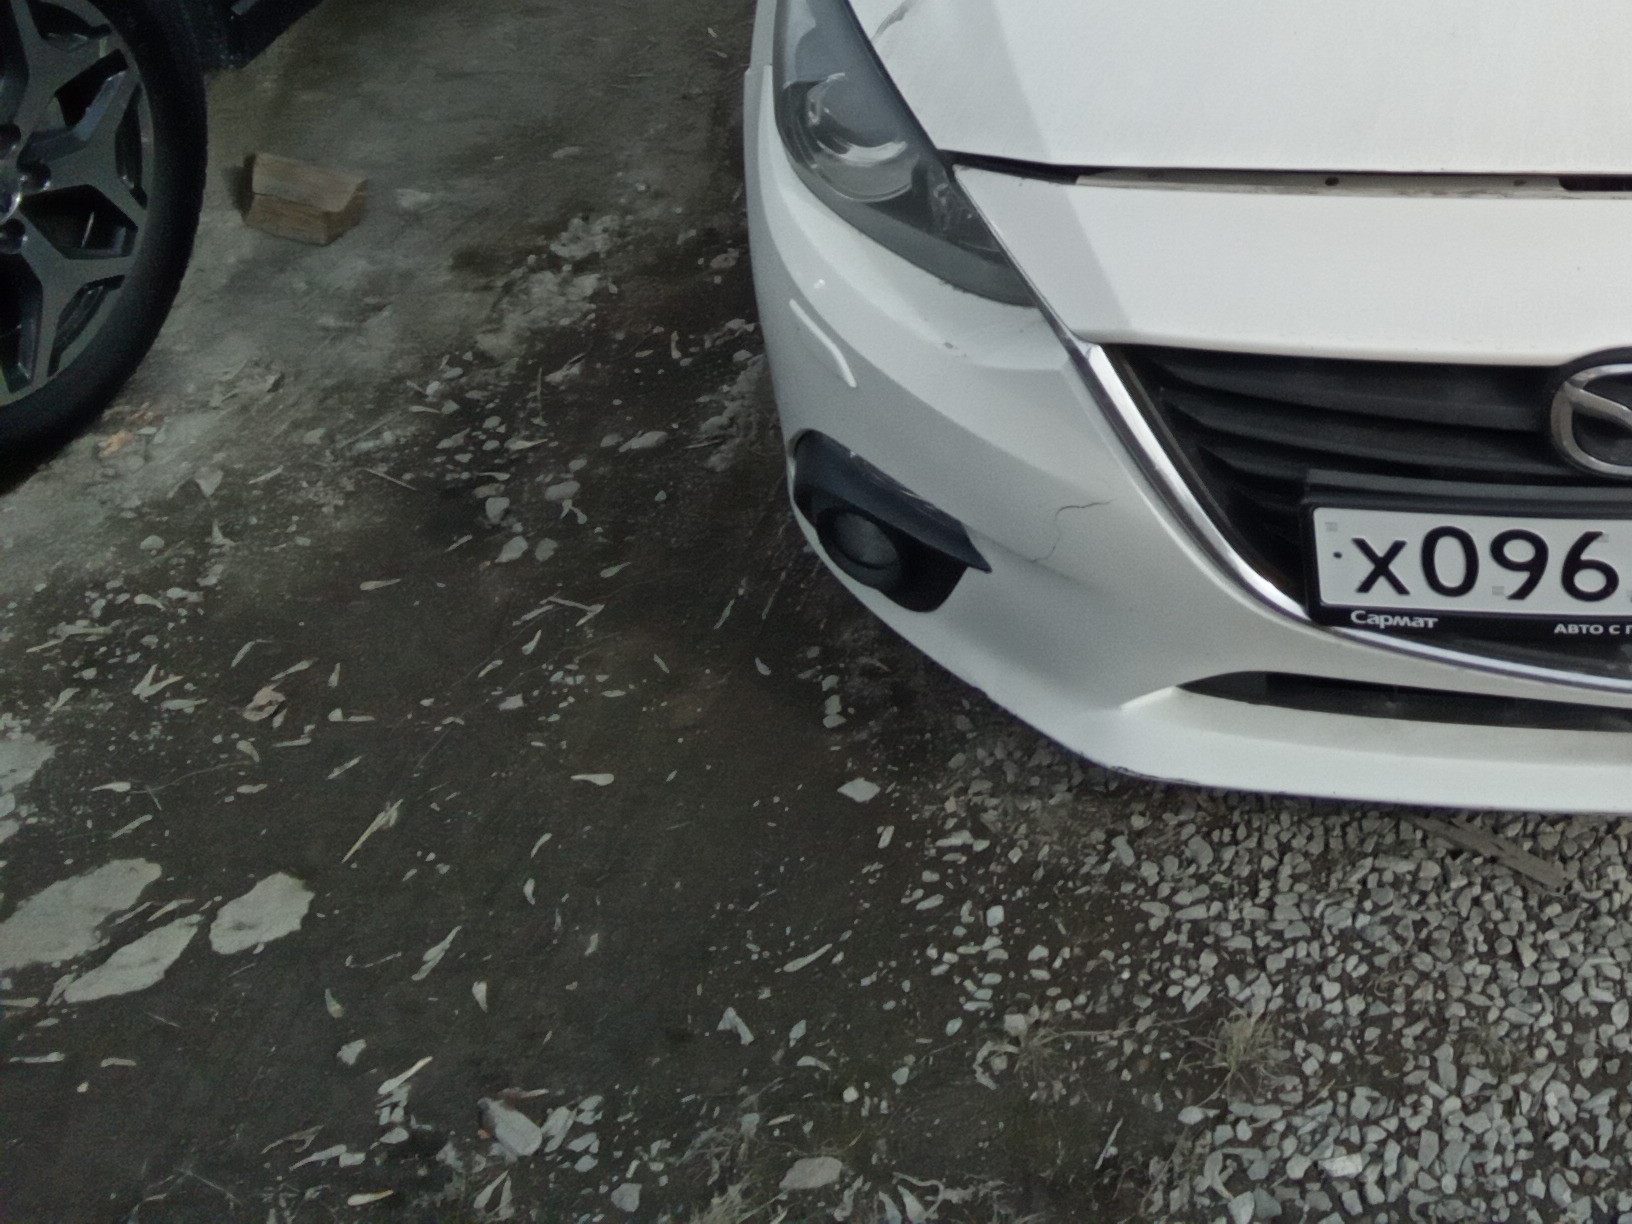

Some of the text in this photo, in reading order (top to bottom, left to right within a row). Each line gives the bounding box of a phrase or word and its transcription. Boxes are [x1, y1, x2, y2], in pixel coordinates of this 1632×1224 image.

[1349, 609, 1439, 629] Сармат
[1553, 622, 1604, 635] АВТО
[1608, 624, 1621, 636] С
